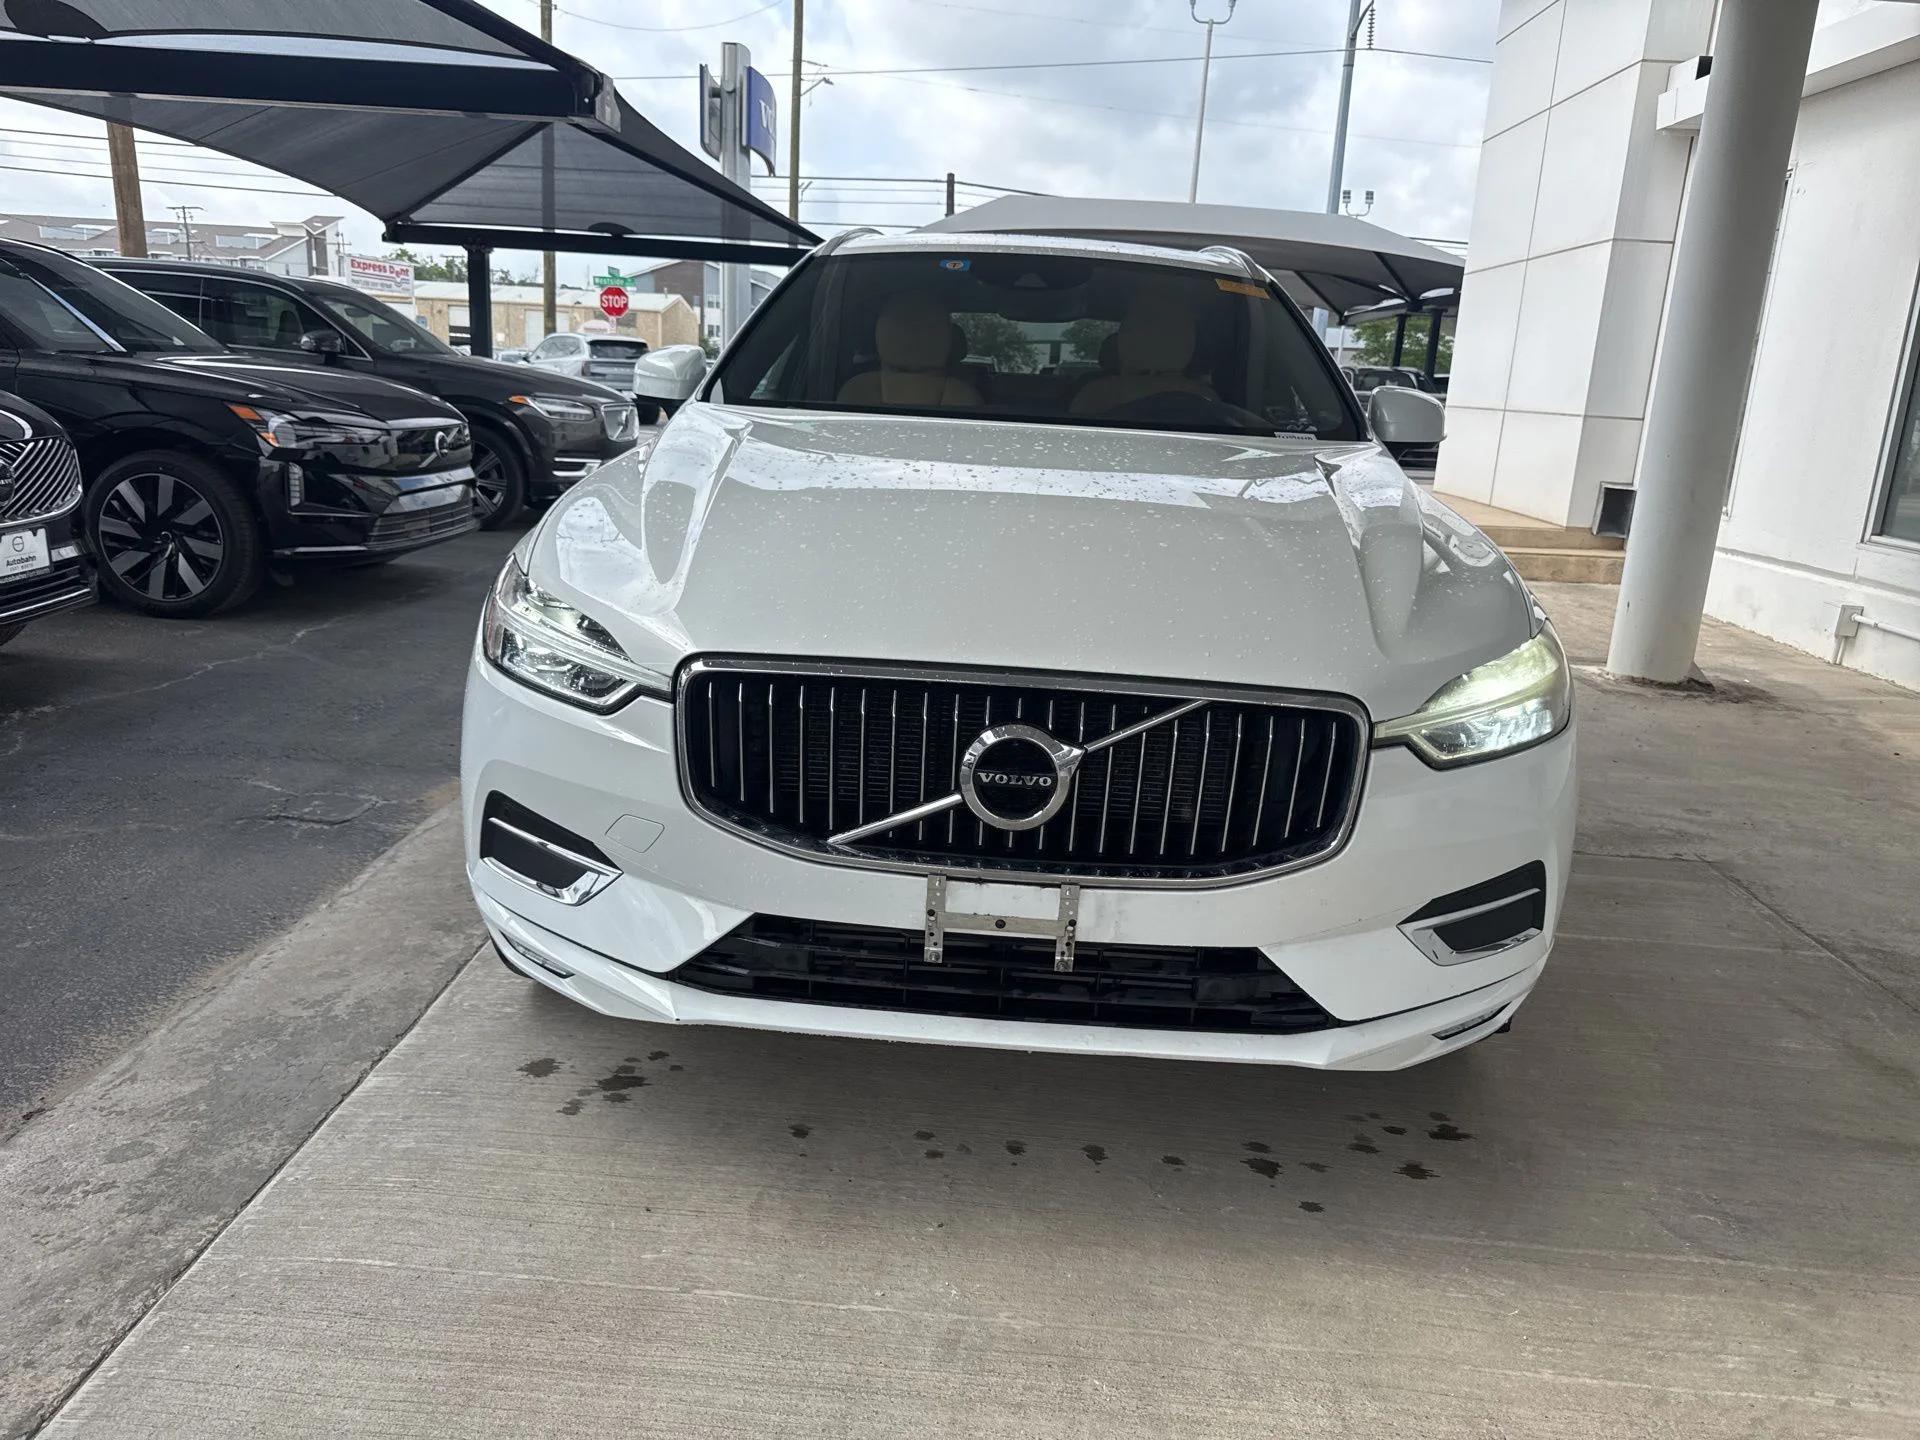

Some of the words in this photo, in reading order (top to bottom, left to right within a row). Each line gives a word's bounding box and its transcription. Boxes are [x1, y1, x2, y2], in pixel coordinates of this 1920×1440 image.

[351, 259, 387, 273] Express
[389, 265, 410, 278] Dent
[601, 295, 628, 308] STOP
[6, 555, 37, 567] Autobahn
[977, 772, 1052, 787] VOLVO
